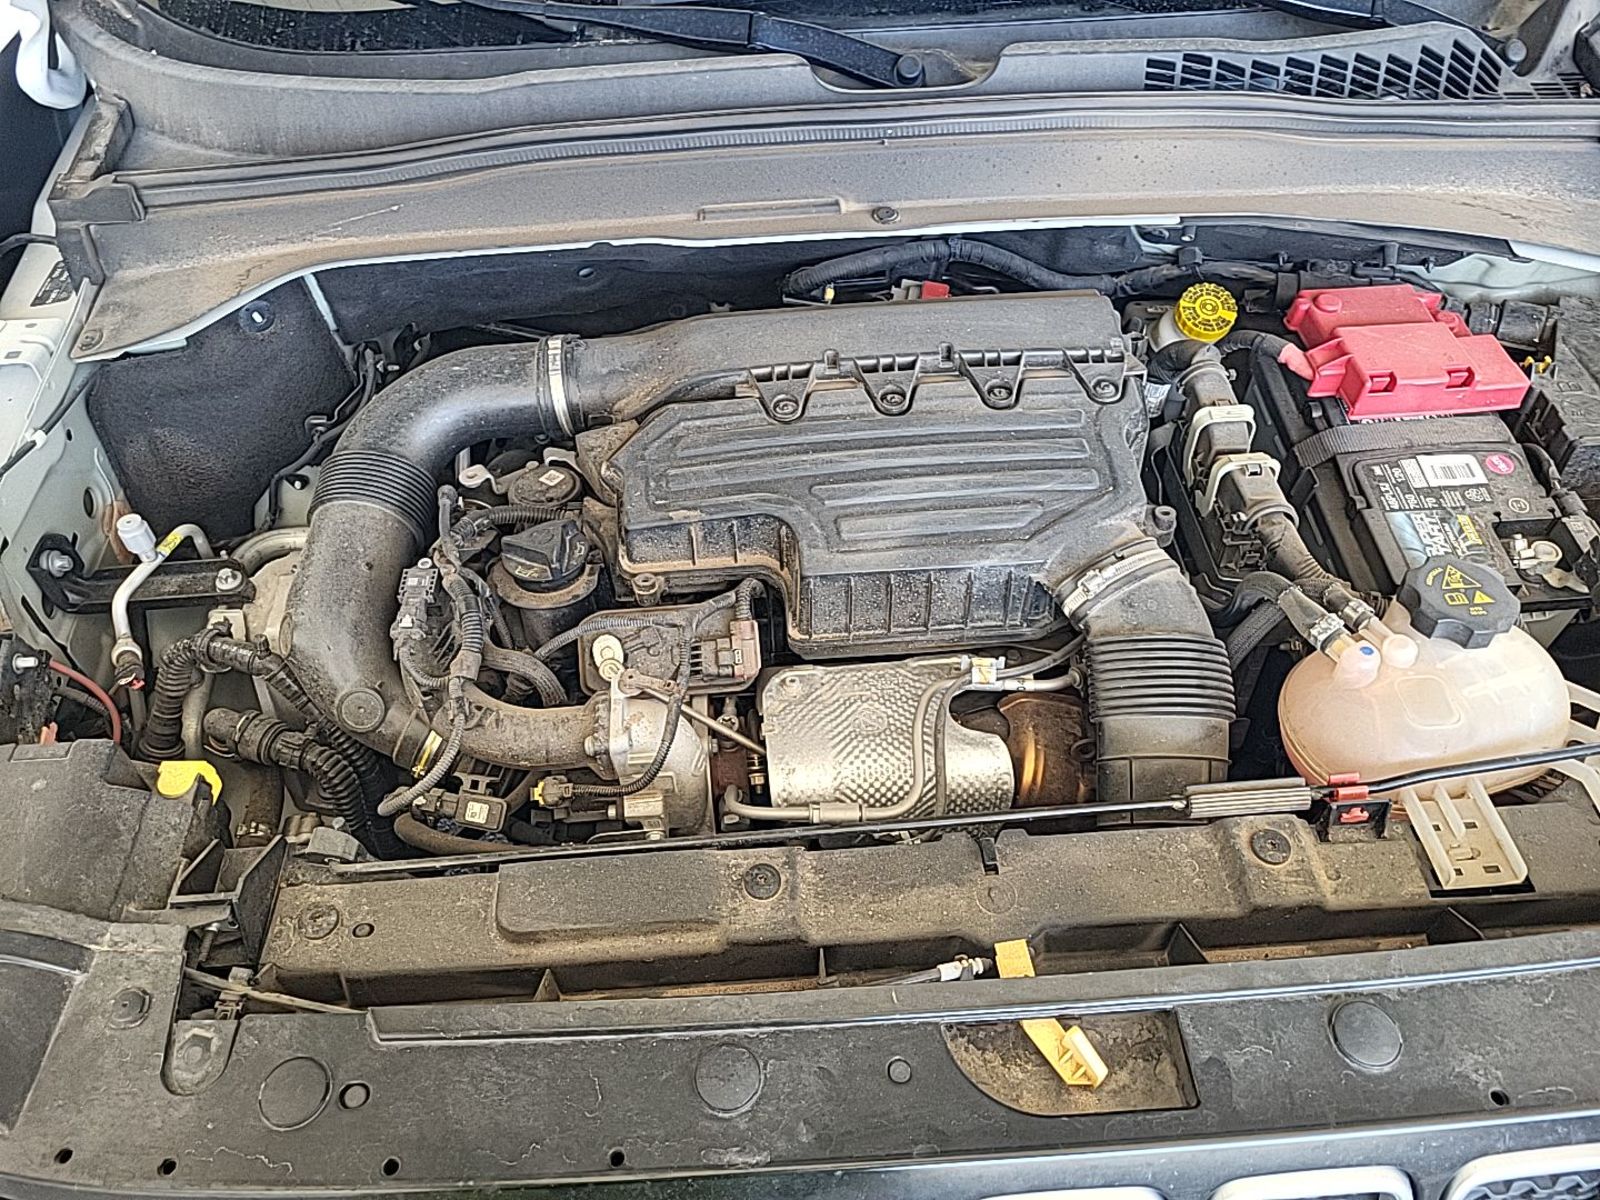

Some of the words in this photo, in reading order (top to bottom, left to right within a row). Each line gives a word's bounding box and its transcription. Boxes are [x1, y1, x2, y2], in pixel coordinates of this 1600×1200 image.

[1391, 467, 1406, 483] 120
[1404, 493, 1420, 510] 760
[1426, 497, 1439, 509] 70
